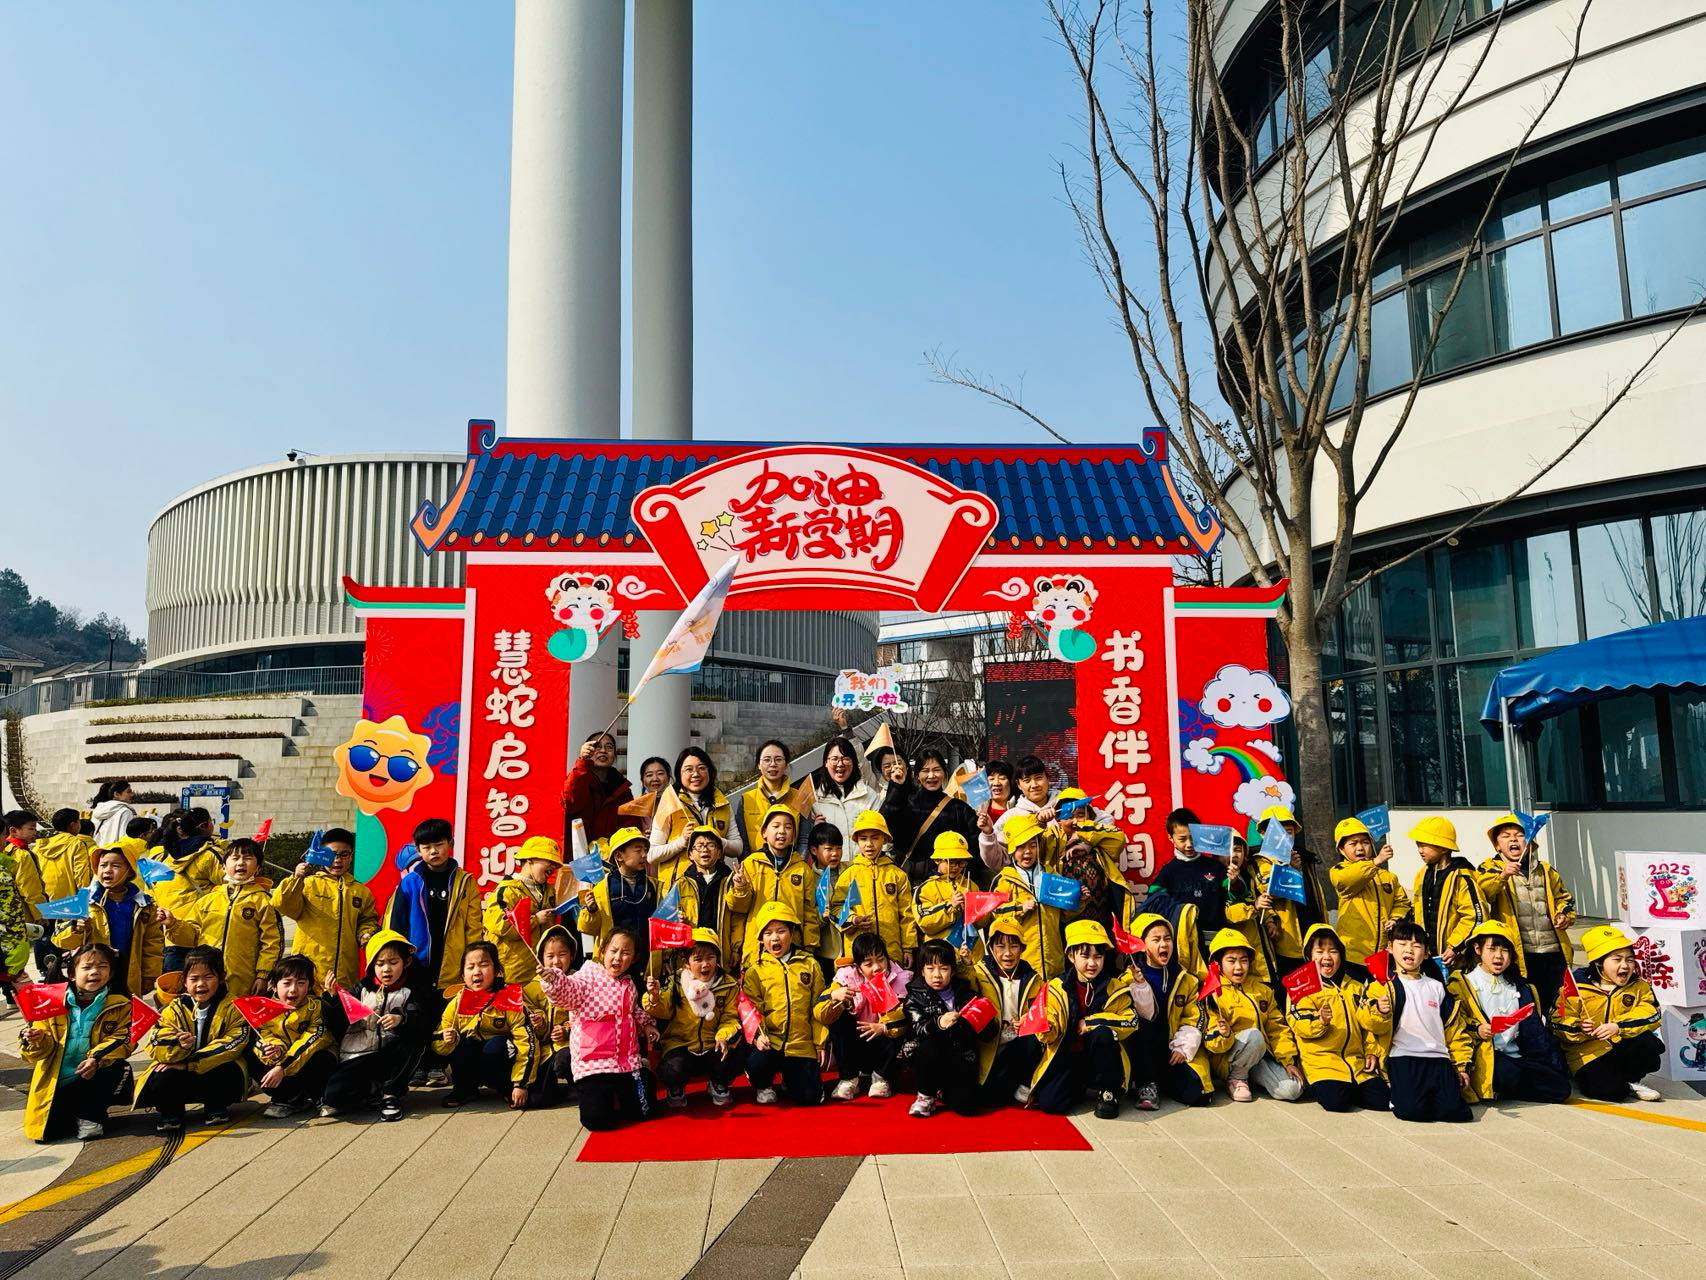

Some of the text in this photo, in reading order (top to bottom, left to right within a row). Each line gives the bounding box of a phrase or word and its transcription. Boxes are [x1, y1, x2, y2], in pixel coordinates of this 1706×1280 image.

[728, 459, 886, 514] 加油
[731, 506, 904, 571] 新学期
[841, 691, 898, 708] 开学啦
[849, 676, 888, 691] 我们
[477, 629, 539, 908] 慧蛇启智迎
[1647, 863, 1691, 876] 2025
